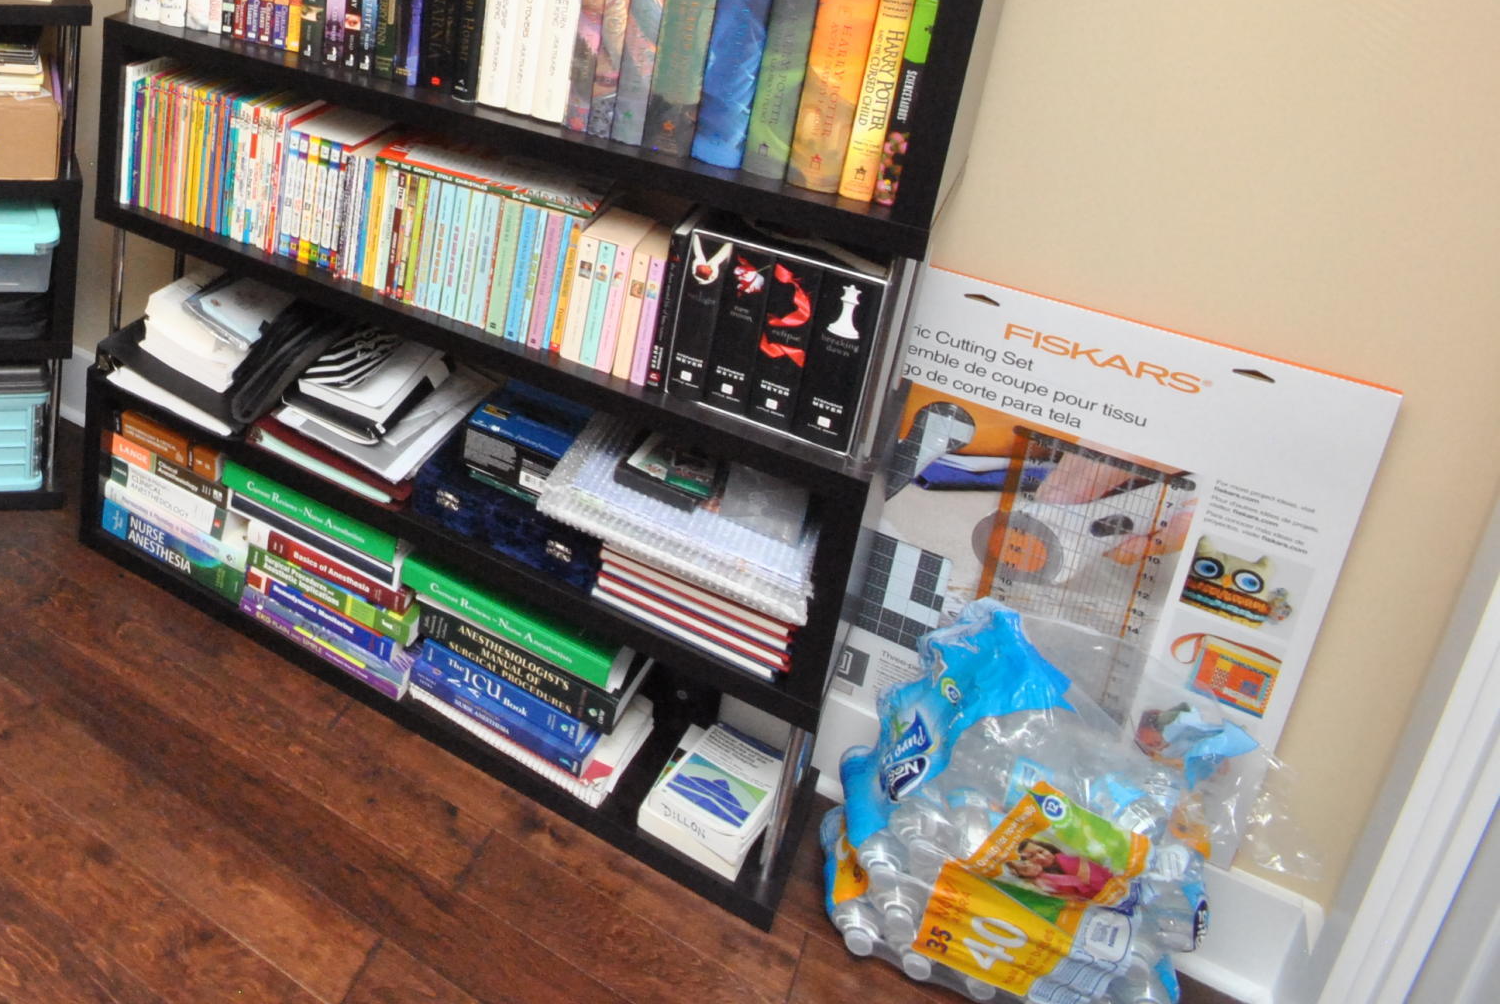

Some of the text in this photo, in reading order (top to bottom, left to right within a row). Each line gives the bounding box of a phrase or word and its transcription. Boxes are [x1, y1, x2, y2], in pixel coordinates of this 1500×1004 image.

[376, 22, 388, 47] FINN
[879, 29, 906, 79] HARRY
[857, 56, 881, 127] CURSED CHILD
[868, 79, 894, 132] POTTER
[676, 356, 703, 369] MEYER
[935, 330, 998, 363] Cutting
[1001, 350, 1035, 372] Set
[1003, 323, 1202, 394] FISKARS
[716, 369, 745, 382] MEYER
[760, 384, 790, 397] MEYER
[907, 343, 1148, 428] emble de coupe pour tissu
[812, 401, 843, 415] MEYER
[926, 369, 949, 386] de
[952, 379, 998, 401] corte
[1000, 393, 1043, 417] para
[1048, 407, 1083, 429] tela
[119, 443, 148, 465] LANGE
[129, 515, 165, 544] NURSE
[128, 529, 192, 575] ANESTHESIA
[293, 550, 371, 594] Basics of Anesthesia
[448, 640, 573, 715] SURGICAL PROCEDURES
[458, 624, 571, 693] ANESTHESIOLOGIST'S
[481, 648, 542, 687] MANUAL OF
[448, 658, 529, 717] The ICU Book
[661, 802, 707, 839] DILLON
[926, 925, 954, 955] 35
[962, 915, 1029, 970] 40
